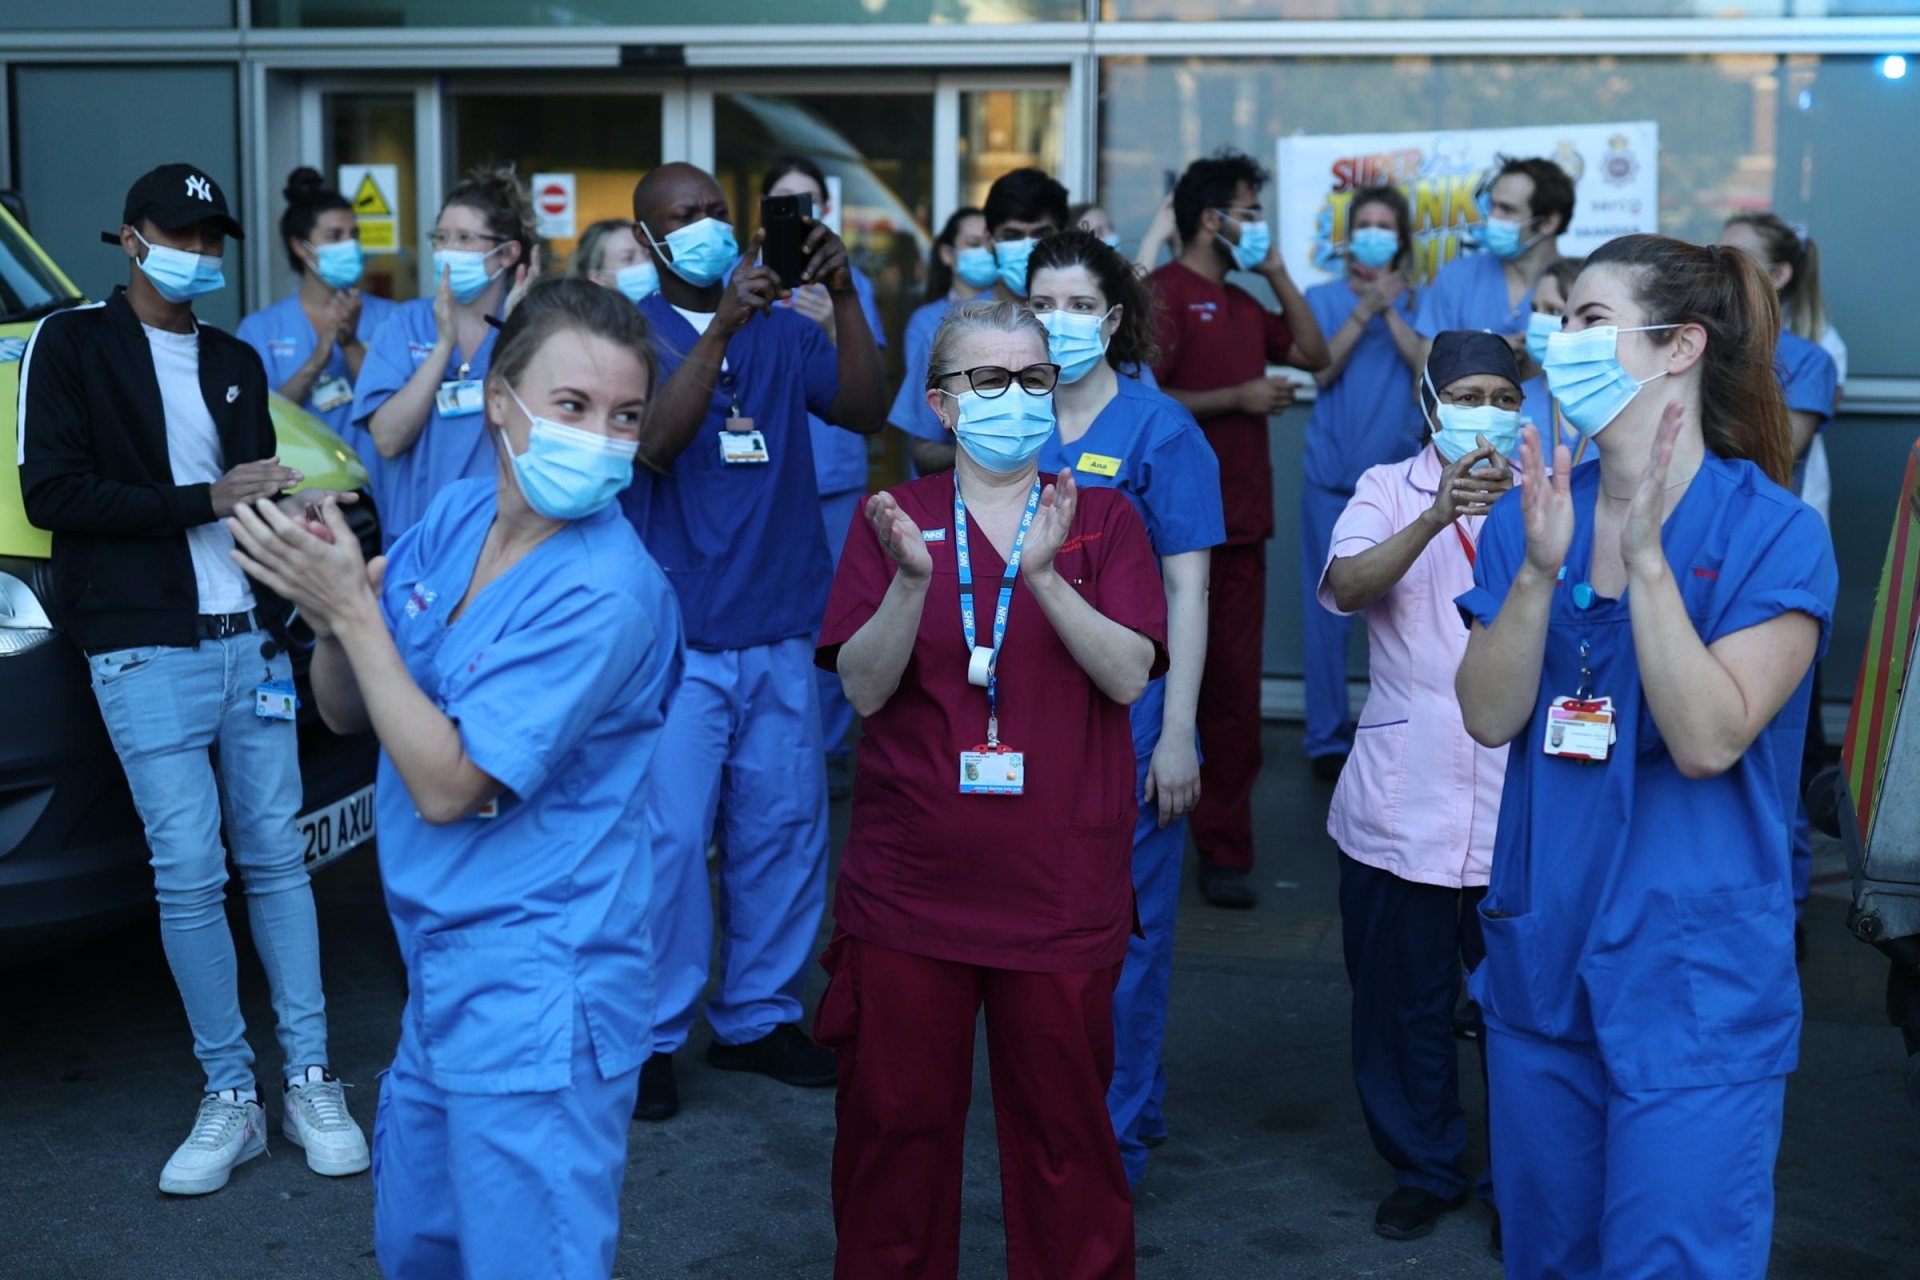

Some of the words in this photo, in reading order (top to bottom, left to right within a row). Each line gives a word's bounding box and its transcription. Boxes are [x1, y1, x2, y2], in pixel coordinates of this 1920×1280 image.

[1331, 148, 1421, 191] SUPER
[185, 174, 213, 202] NY
[1327, 171, 1483, 243] TNK
[1090, 461, 1107, 470] Ana
[1028, 491, 1039, 508] NHS
[956, 508, 965, 525] NHS
[1022, 511, 1033, 527] NHS
[923, 531, 943, 539] NHS
[957, 530, 966, 547] NHS
[959, 551, 969, 568] NHS
[1010, 551, 1021, 566] NHS
[963, 610, 974, 629] NHS
[996, 605, 1007, 626] NHS
[300, 815, 330, 864] 20
[338, 792, 374, 848] AXU
